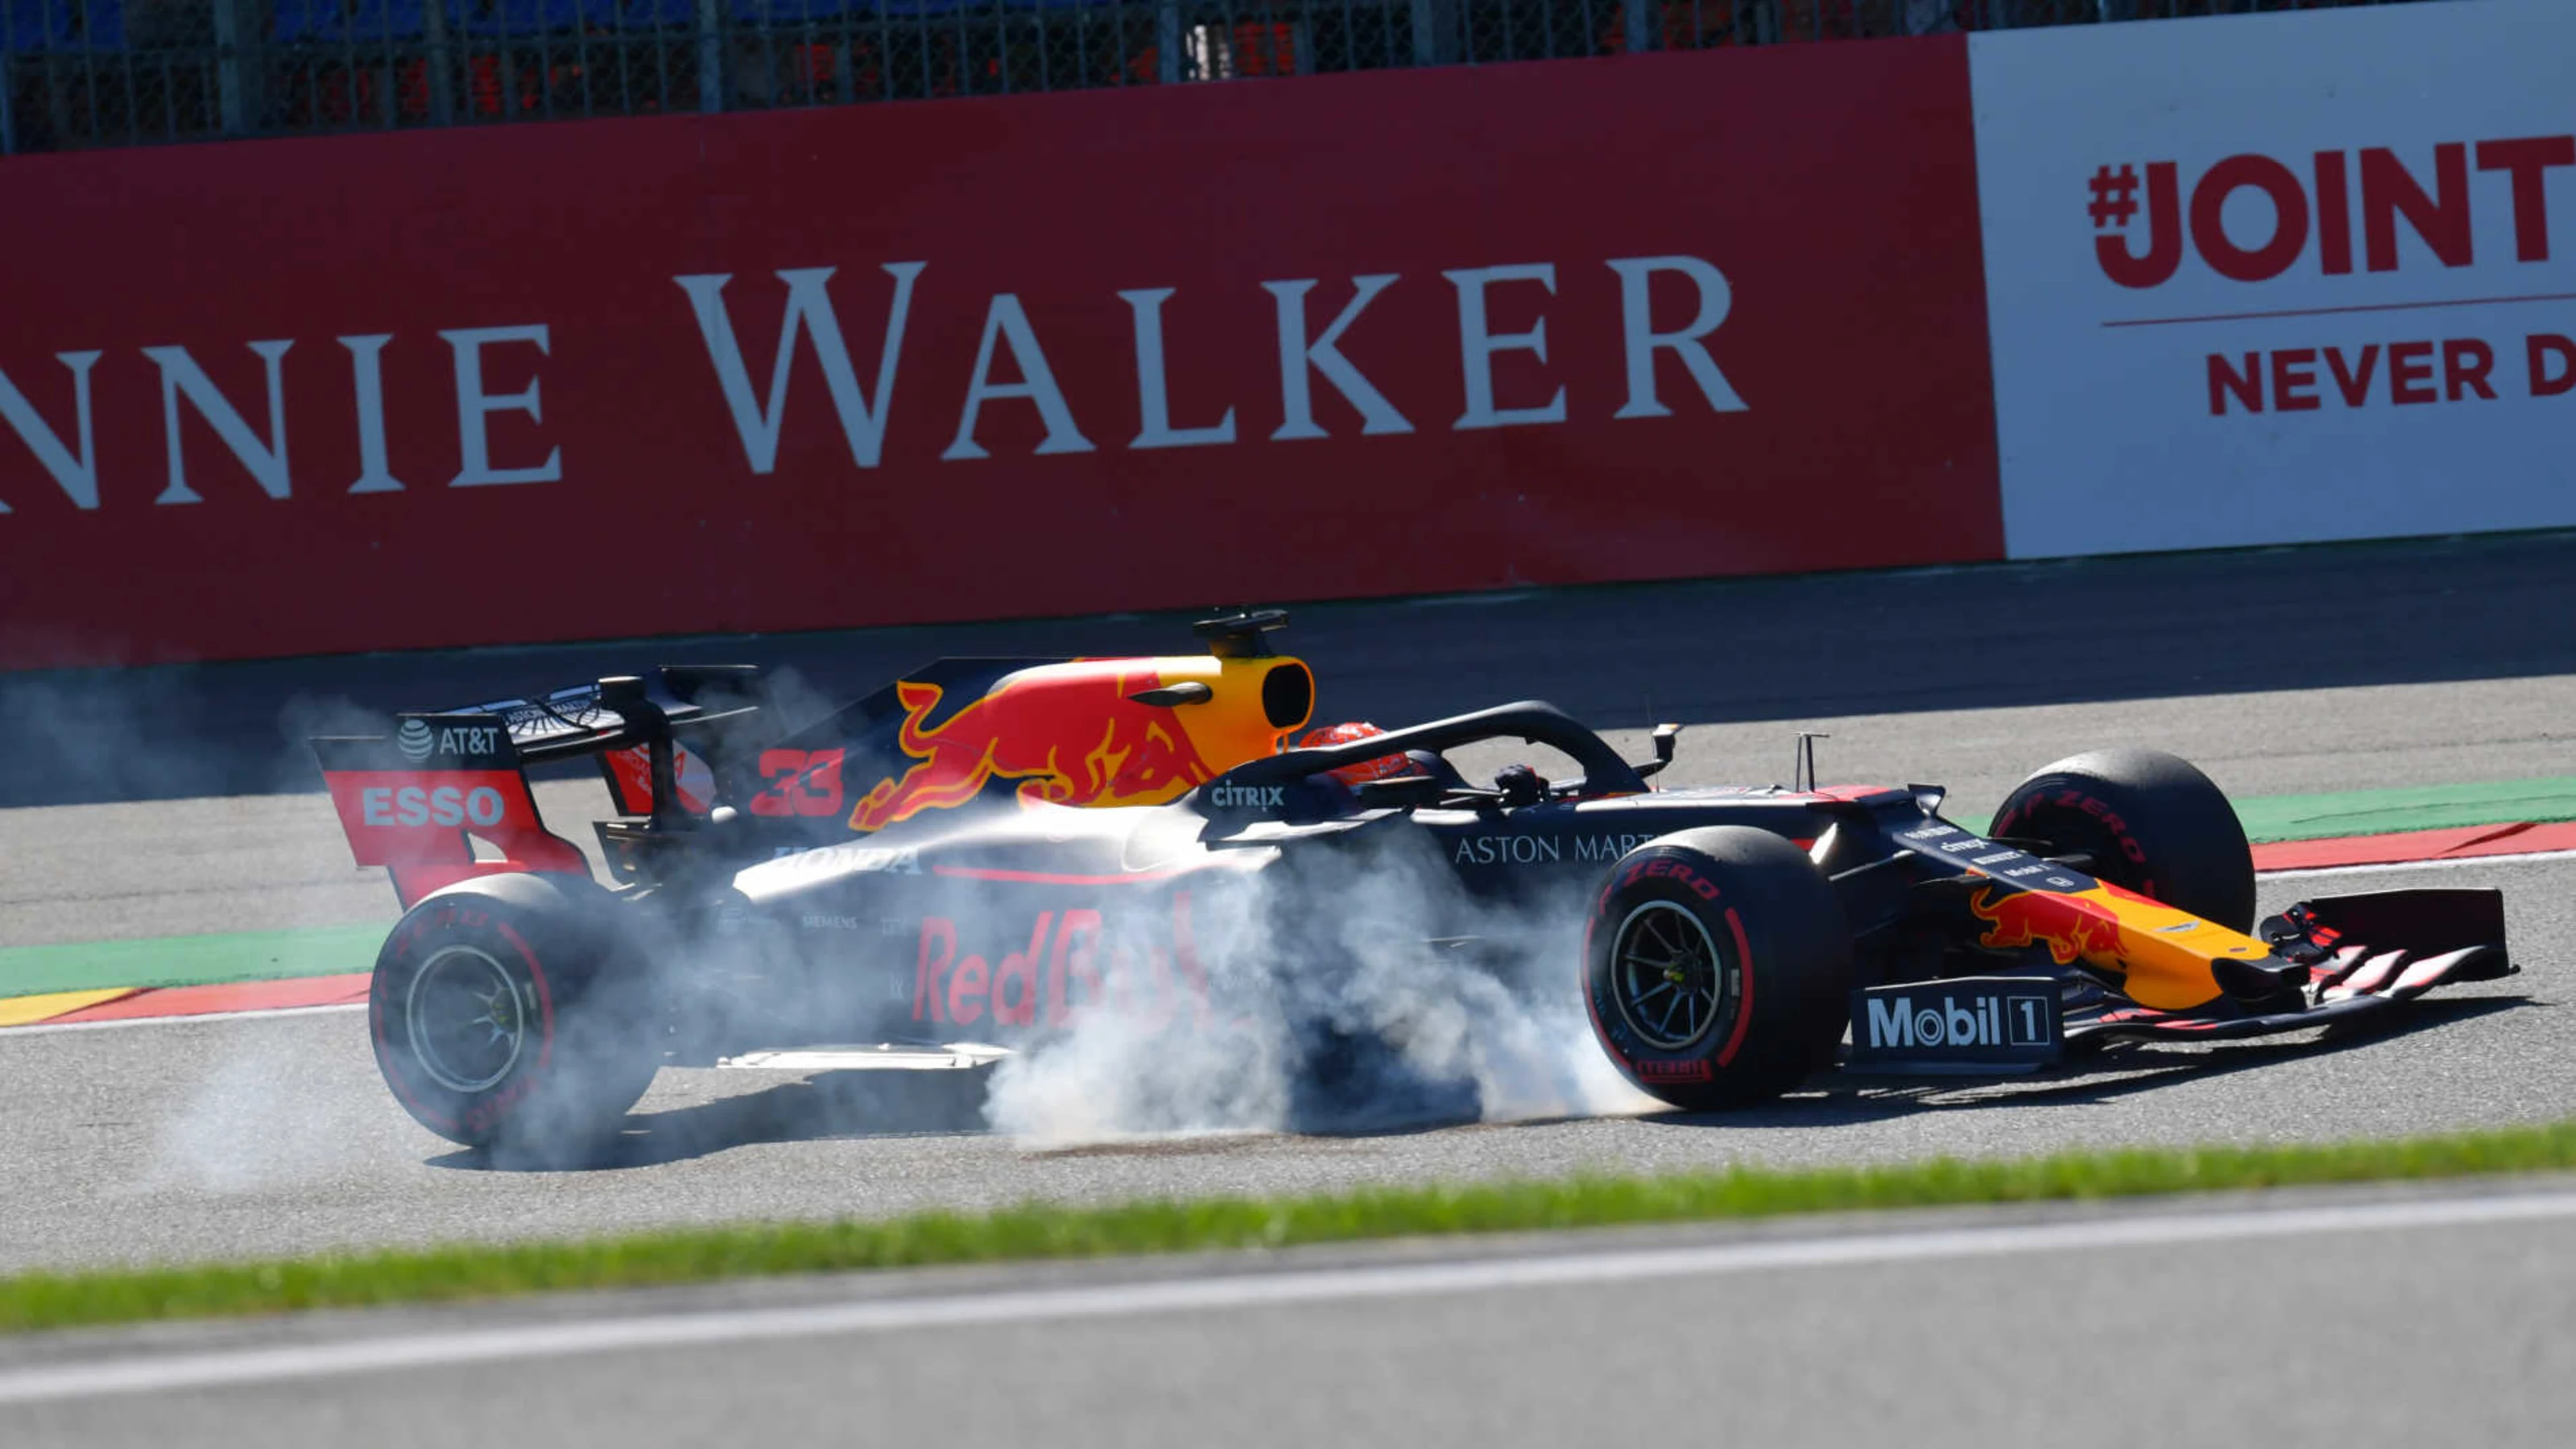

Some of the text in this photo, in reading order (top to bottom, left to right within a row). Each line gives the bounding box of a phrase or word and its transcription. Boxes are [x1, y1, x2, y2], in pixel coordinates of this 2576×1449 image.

[2087, 134, 2576, 290] #JOINT
[672, 254, 1751, 475] WALKER
[2206, 337, 2498, 417] NEVER
[440, 726, 498, 755] AT&T
[362, 786, 505, 827] ESSO
[750, 748, 845, 817] 33
[1456, 836, 1560, 864] ASTON
[2057, 790, 2146, 864] ZERO
[1623, 860, 1722, 901] ZERO
[1867, 996, 2001, 1047] Mobil
